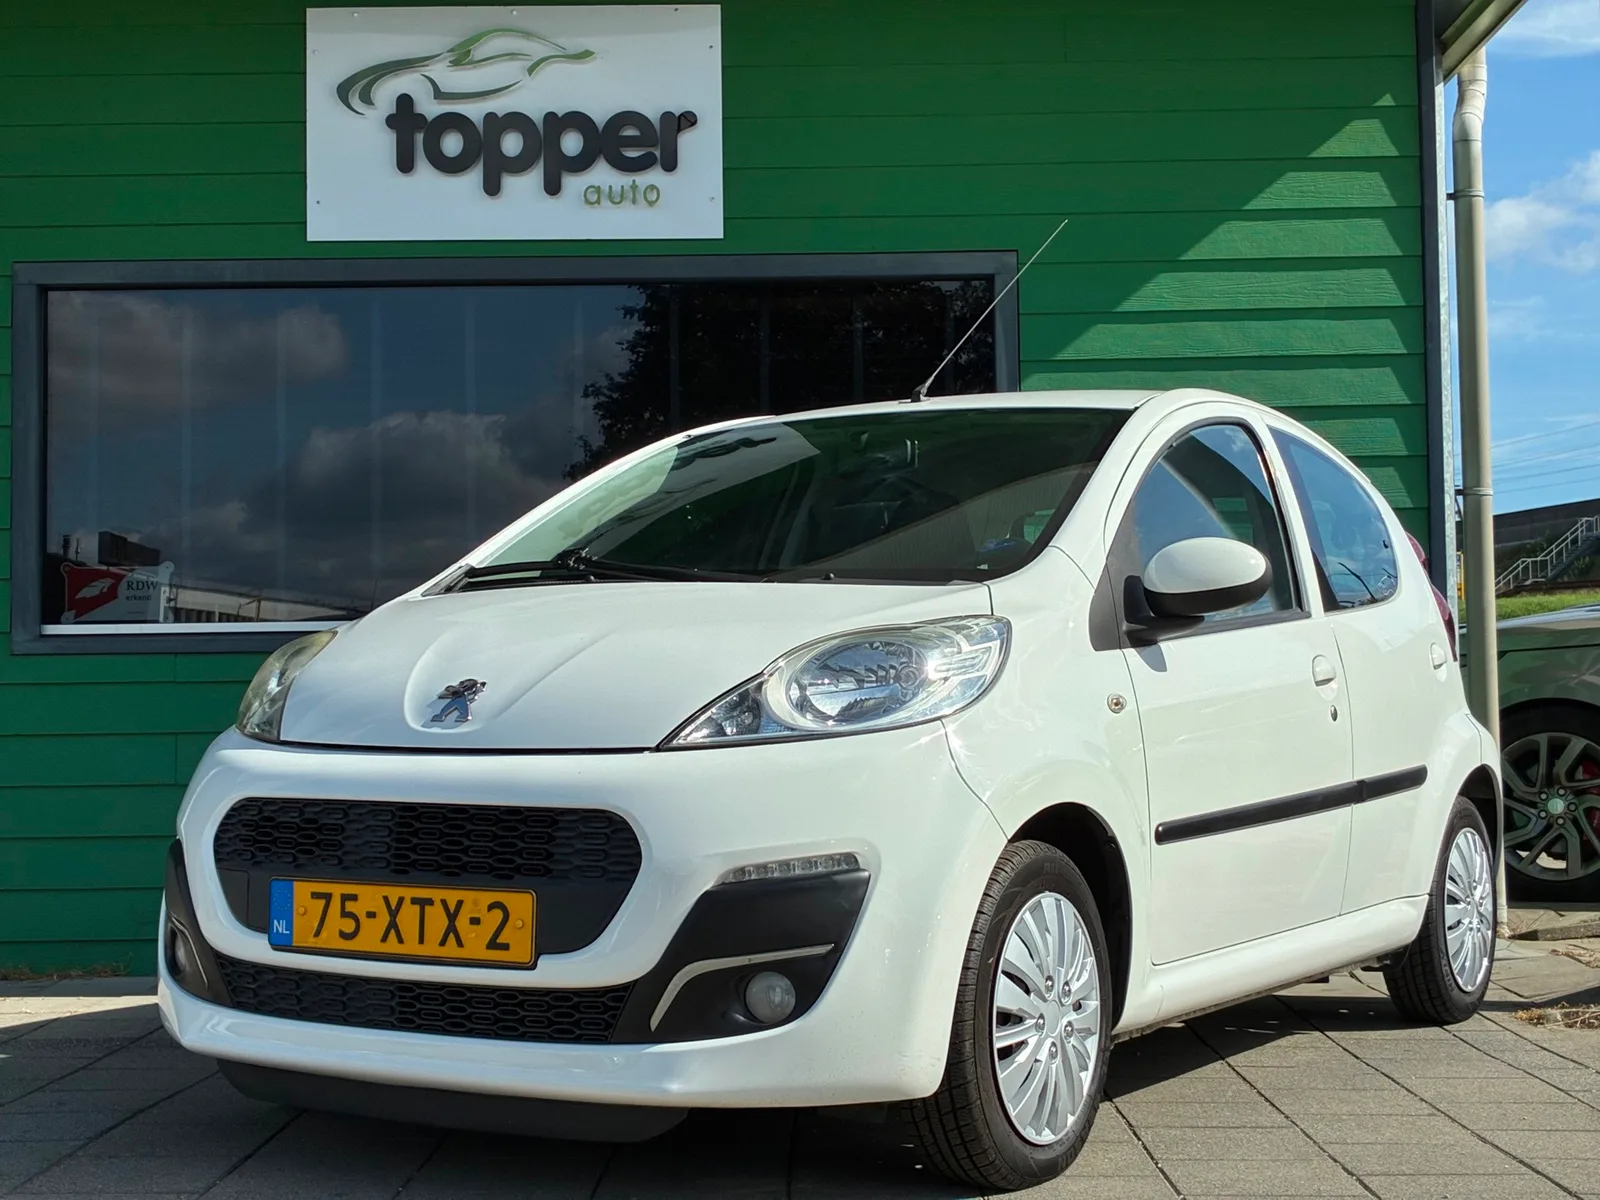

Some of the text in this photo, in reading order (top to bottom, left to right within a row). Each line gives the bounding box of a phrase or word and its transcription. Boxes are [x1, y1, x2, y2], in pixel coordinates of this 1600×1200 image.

[385, 93, 697, 197] topper
[583, 179, 661, 207] auto
[127, 580, 158, 591] RDW
[273, 919, 290, 935] NL
[310, 891, 511, 951] 75-XTX-2
